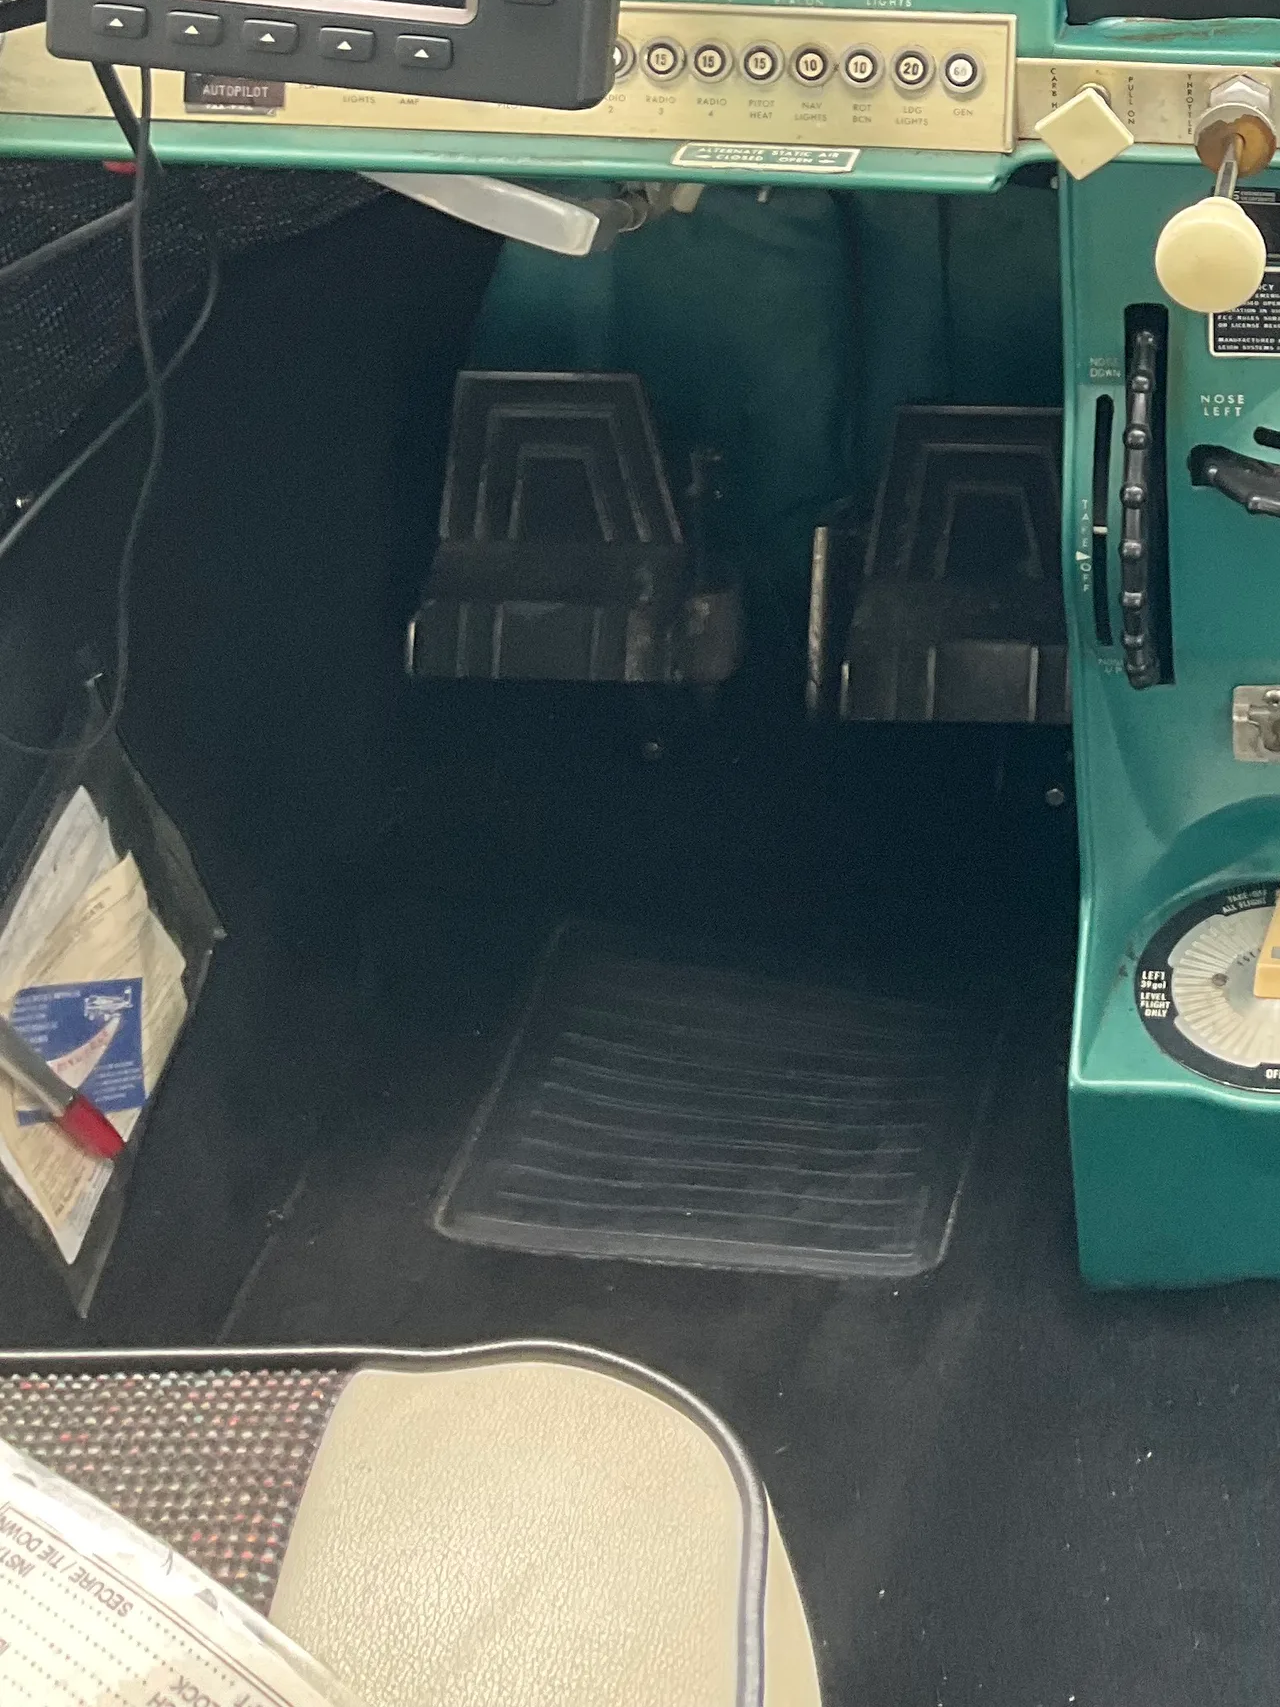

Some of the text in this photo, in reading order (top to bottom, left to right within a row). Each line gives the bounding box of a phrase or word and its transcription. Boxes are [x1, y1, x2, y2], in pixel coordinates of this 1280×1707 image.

[804, 58, 919, 76] 10 10 20
[202, 84, 268, 98] AUTOPILOT
[646, 96, 676, 104] RADIO
[697, 98, 727, 106] RADIO
[750, 111, 773, 119] HEAT
[954, 108, 974, 117] GEN
[794, 113, 827, 122] LIGHTS
[896, 117, 929, 126] LIGHTS
[699, 147, 812, 158] ALTERNATE STATIC
[1200, 394, 1245, 405] NOSE
[1203, 406, 1242, 417] LEFT
[1142, 971, 1165, 980] LEFT
[1140, 992, 1166, 1001] LEVEL
[1140, 1001, 1170, 1010] FLIGHT
[1144, 1009, 1167, 1018] ONLY
[69, 1564, 134, 1618] SECURE
